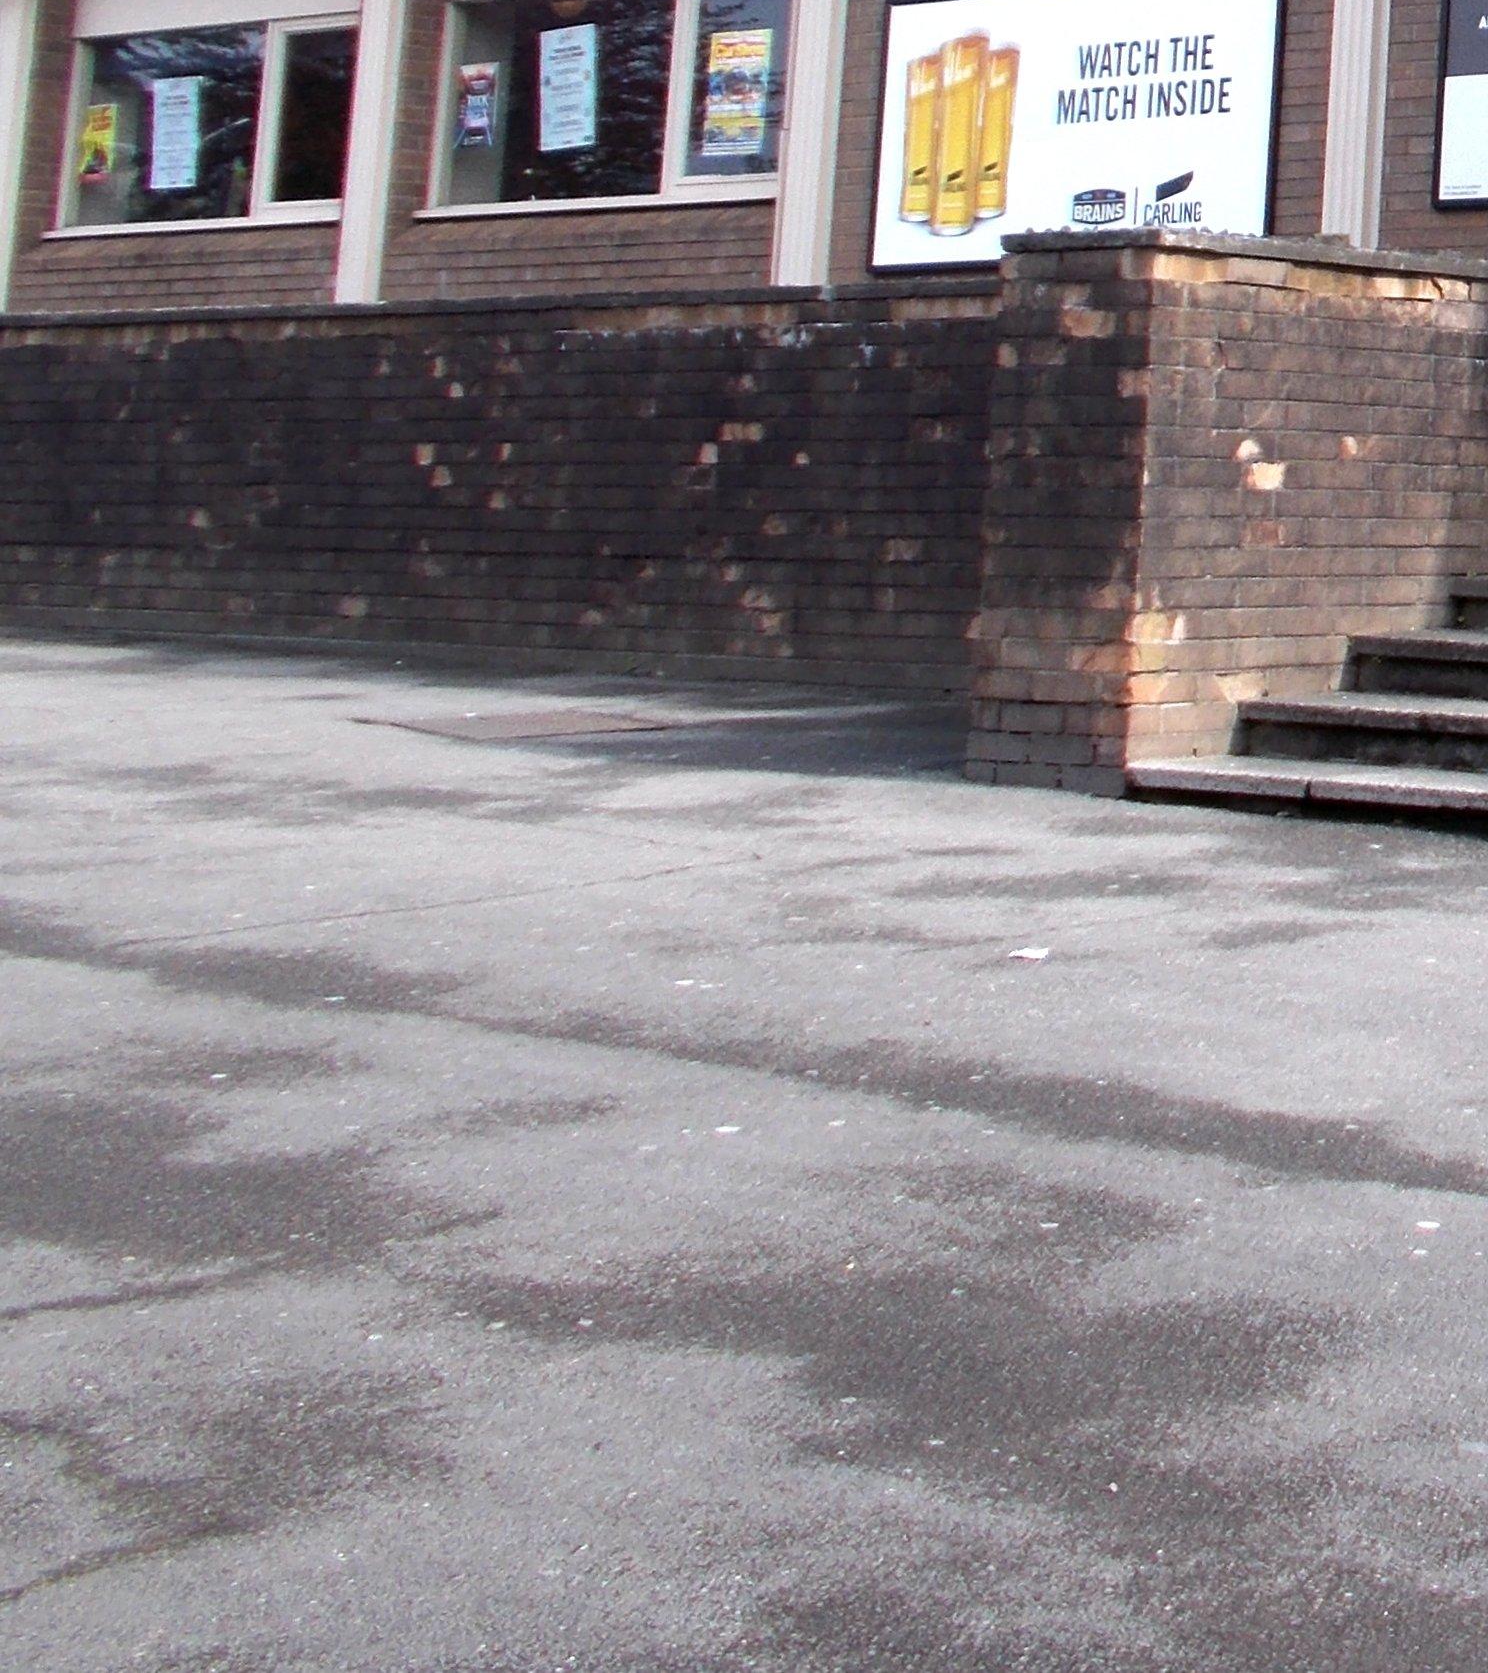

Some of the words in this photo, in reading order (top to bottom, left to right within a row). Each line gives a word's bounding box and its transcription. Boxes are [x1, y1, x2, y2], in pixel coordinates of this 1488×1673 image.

[1078, 39, 1160, 80] WATCH
[1170, 34, 1215, 72] THE
[1056, 84, 1137, 125] MATCH
[1147, 77, 1232, 118] INSIDE
[1074, 204, 1123, 222] BRAINS
[1144, 201, 1202, 224] CARLING
